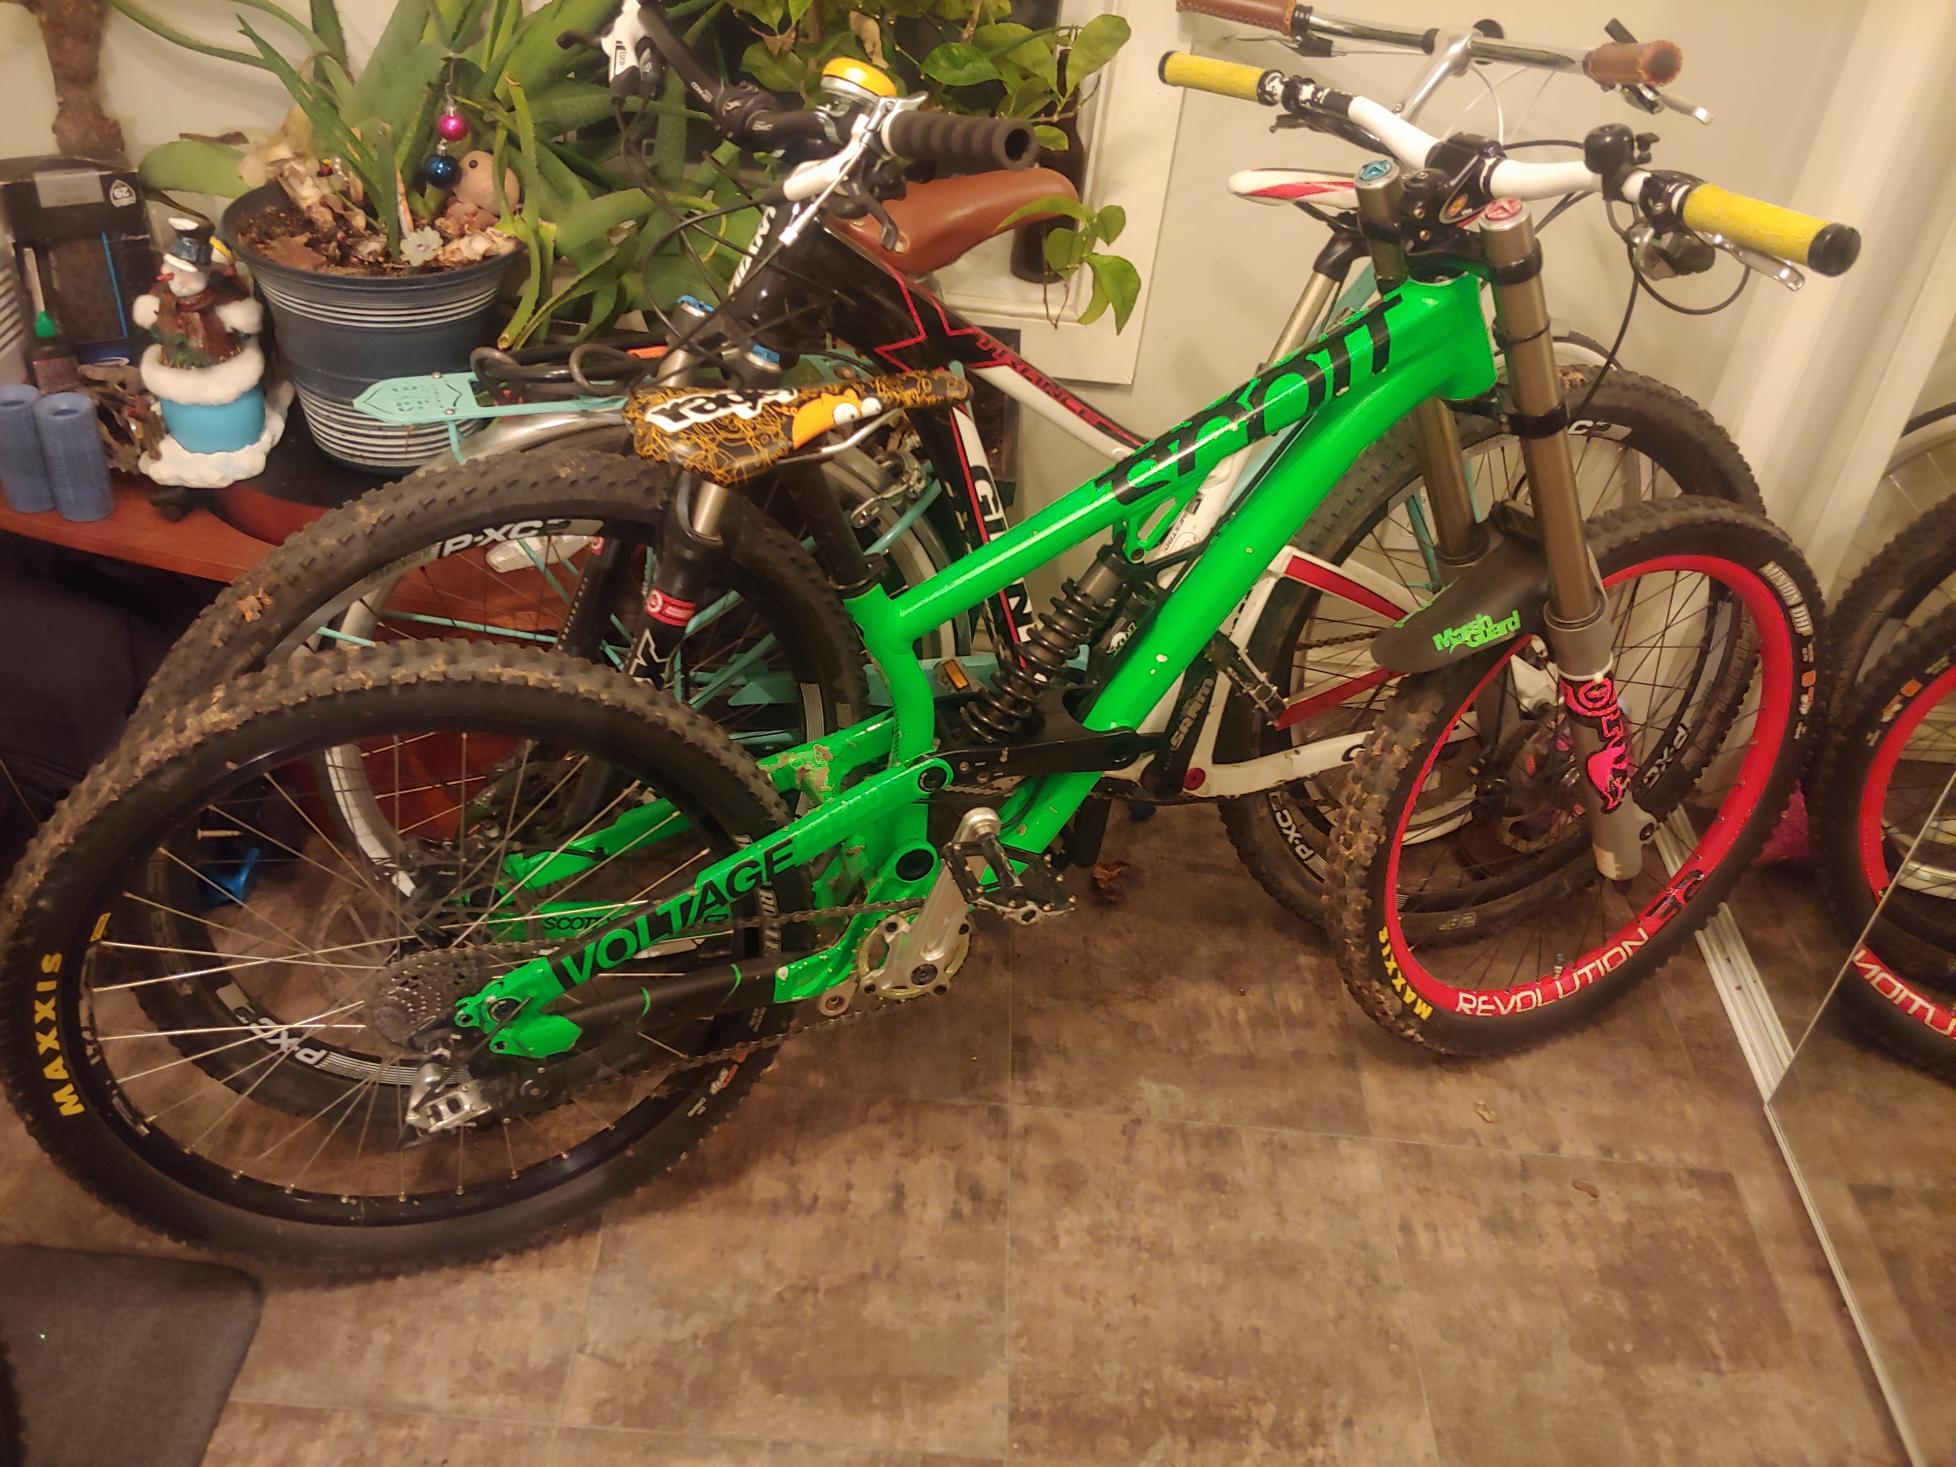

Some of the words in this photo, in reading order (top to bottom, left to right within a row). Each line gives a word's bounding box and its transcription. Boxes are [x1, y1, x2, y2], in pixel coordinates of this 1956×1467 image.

[558, 837, 796, 987] VOLTAGE
[1378, 925, 1434, 1021] MAXXIS
[1455, 926, 1650, 1018] REVOLUTION
[34, 951, 86, 1117] MAXXIS
